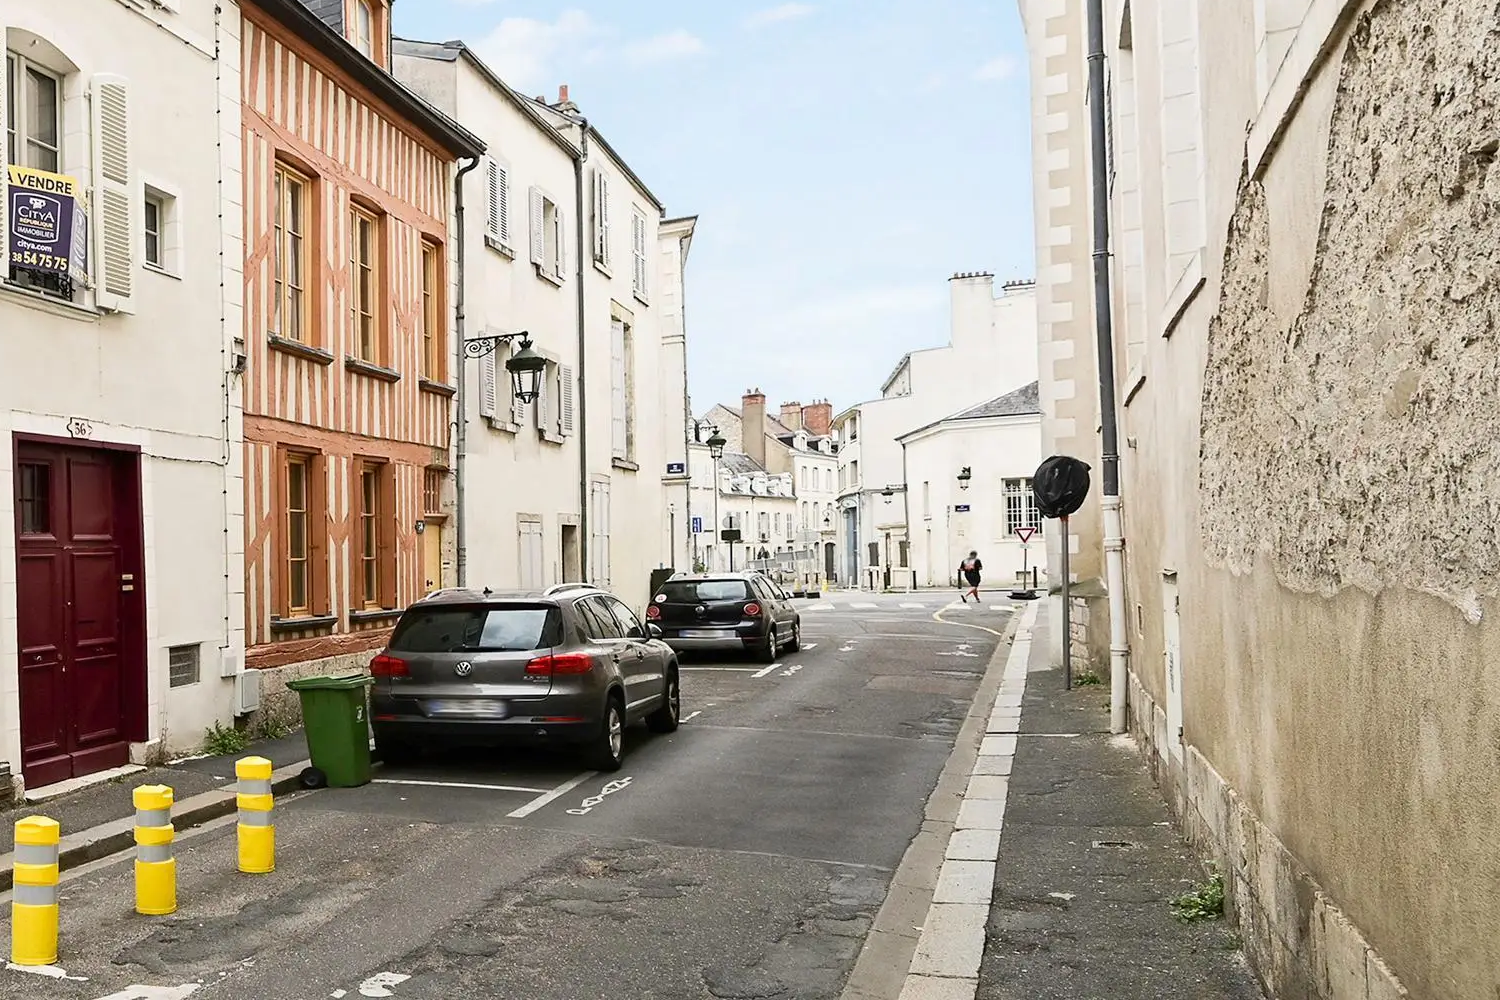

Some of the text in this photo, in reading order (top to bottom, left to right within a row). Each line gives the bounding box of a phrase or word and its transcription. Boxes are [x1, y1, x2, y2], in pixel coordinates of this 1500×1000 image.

[18, 173, 73, 195] VENDRE
[18, 206, 55, 223] CITYA
[17, 226, 55, 239] IMMOBILIER
[17, 239, 53, 253] citya.com
[12, 251, 68, 271] 38 54 75 75
